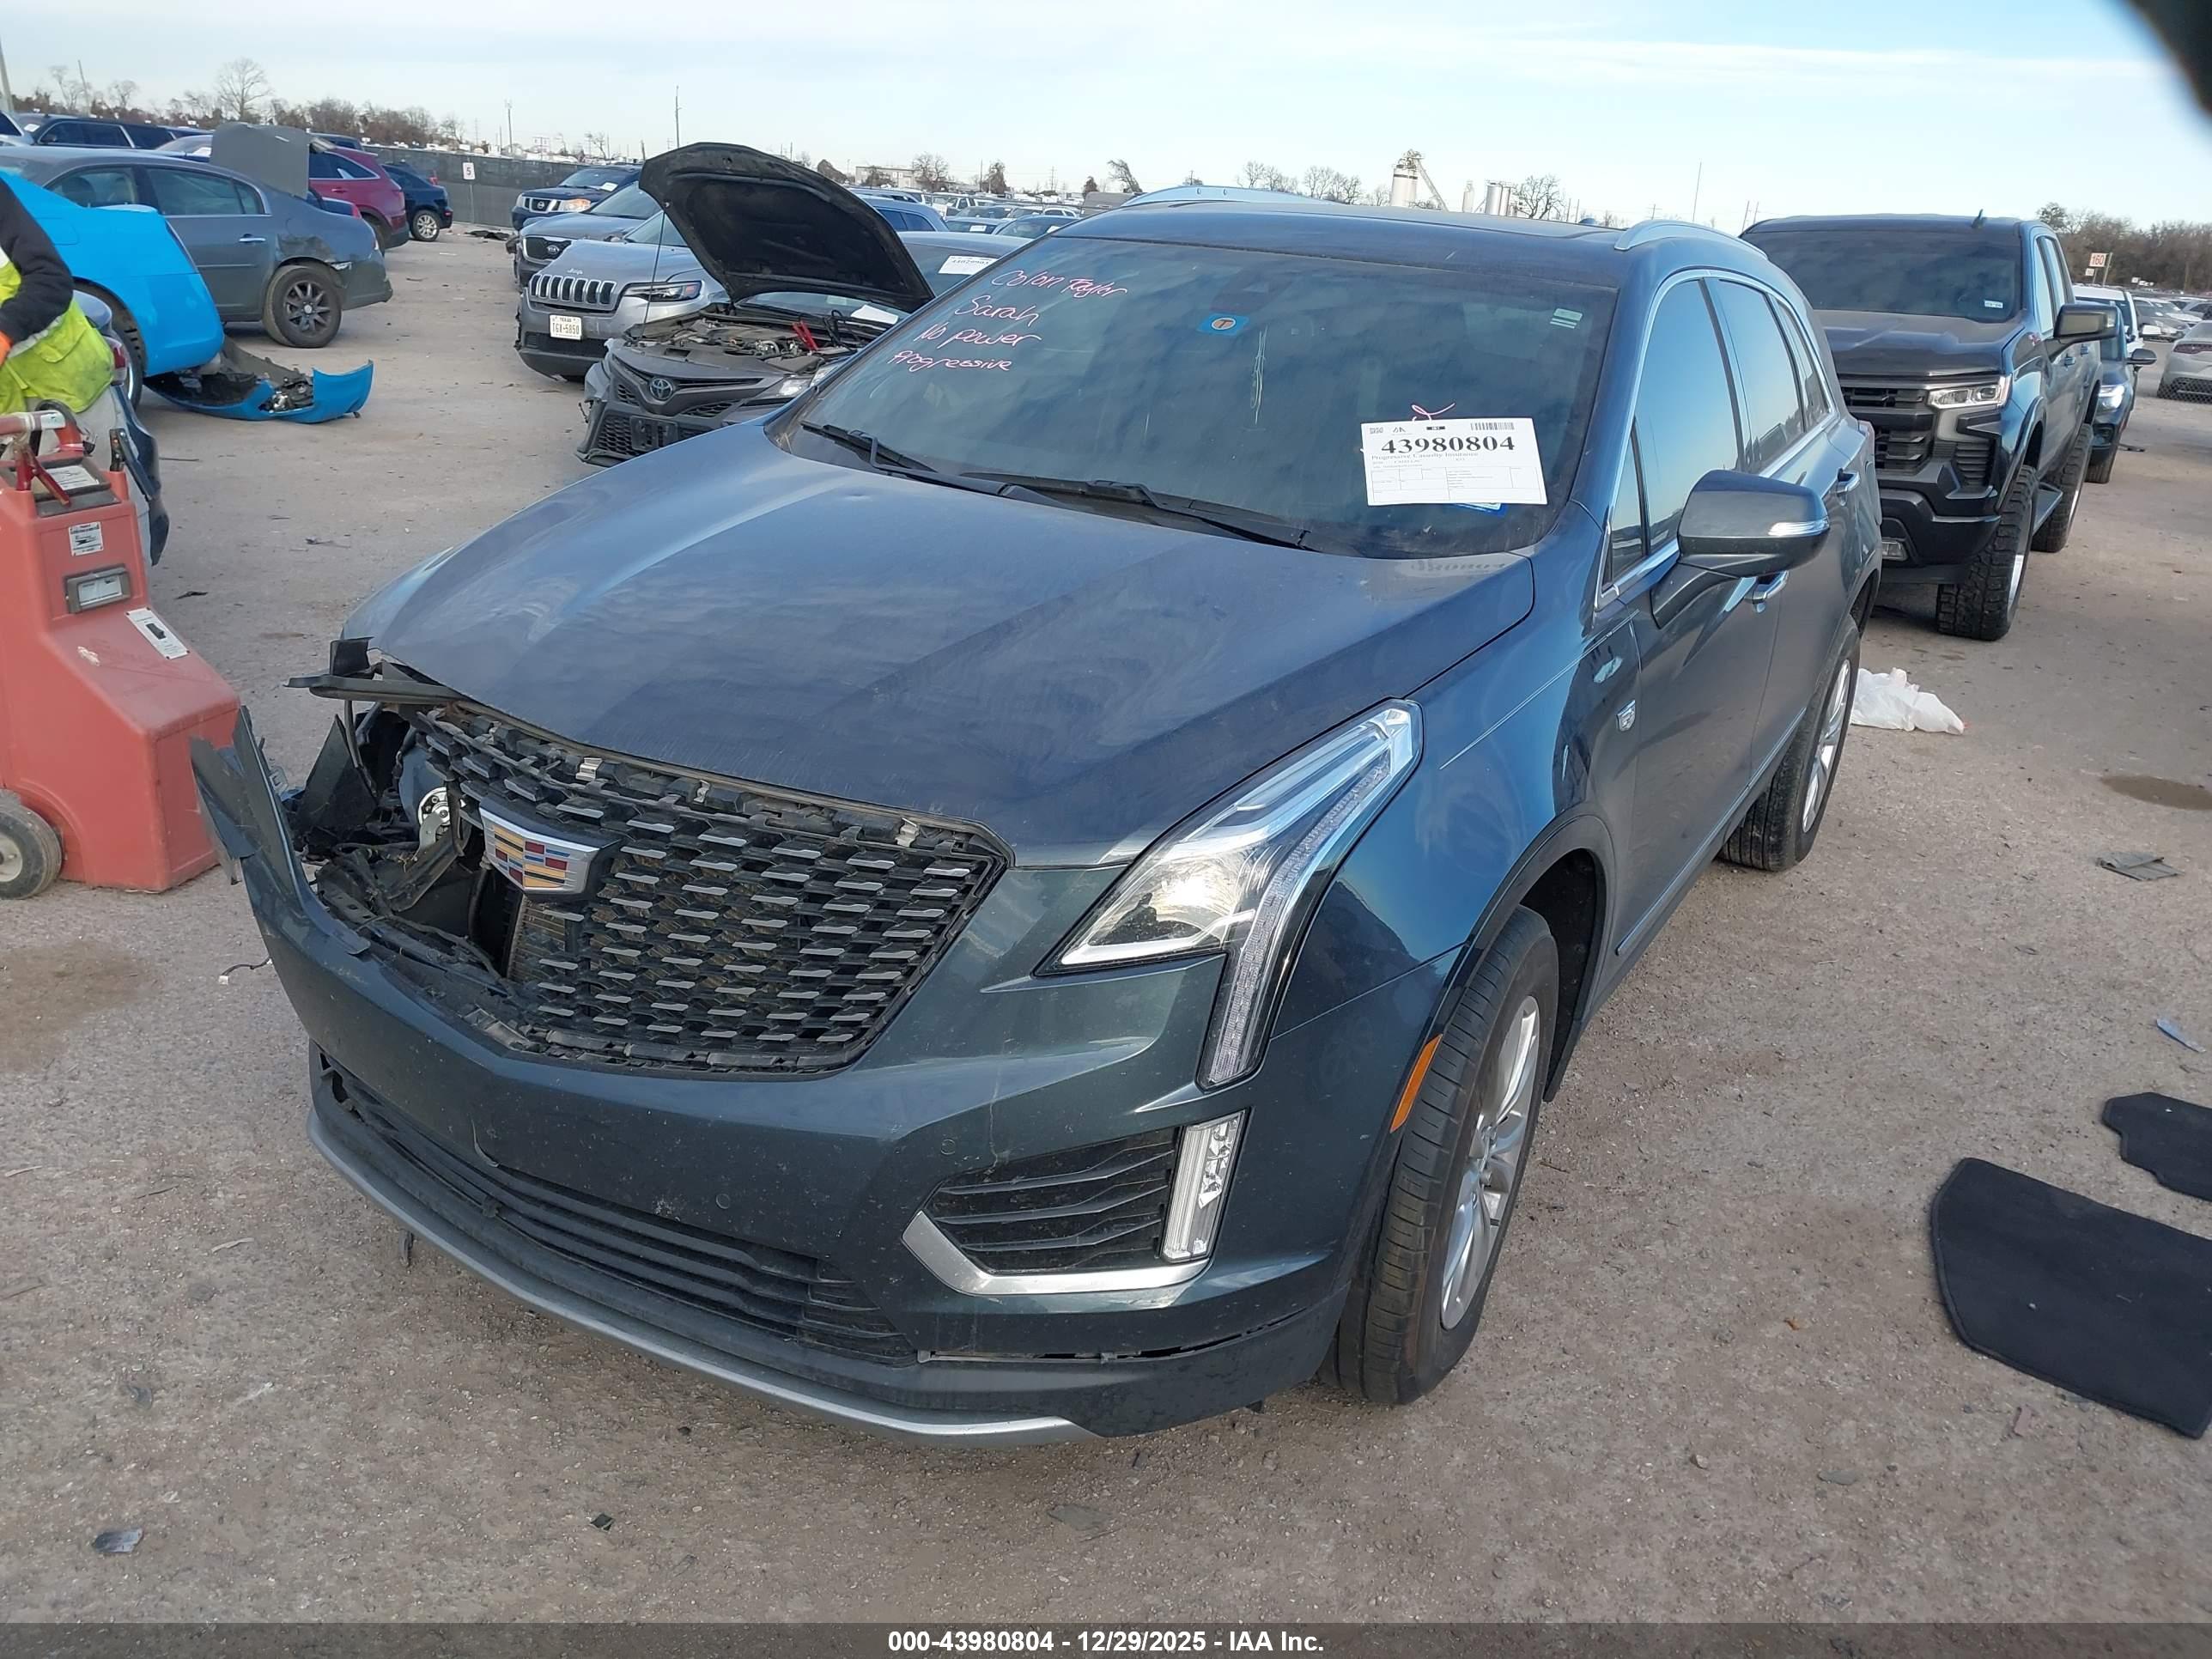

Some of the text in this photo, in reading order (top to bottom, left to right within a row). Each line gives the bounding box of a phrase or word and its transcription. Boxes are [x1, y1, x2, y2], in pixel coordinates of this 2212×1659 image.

[466, 167, 471, 175] 5
[2092, 254, 2105, 265] 160
[992, 270, 1127, 298] Colon Taylor
[954, 295, 1039, 327] Sarah
[915, 321, 1042, 349] No power
[887, 349, 1013, 373] Progressive
[1382, 435, 1516, 454] 43980804
